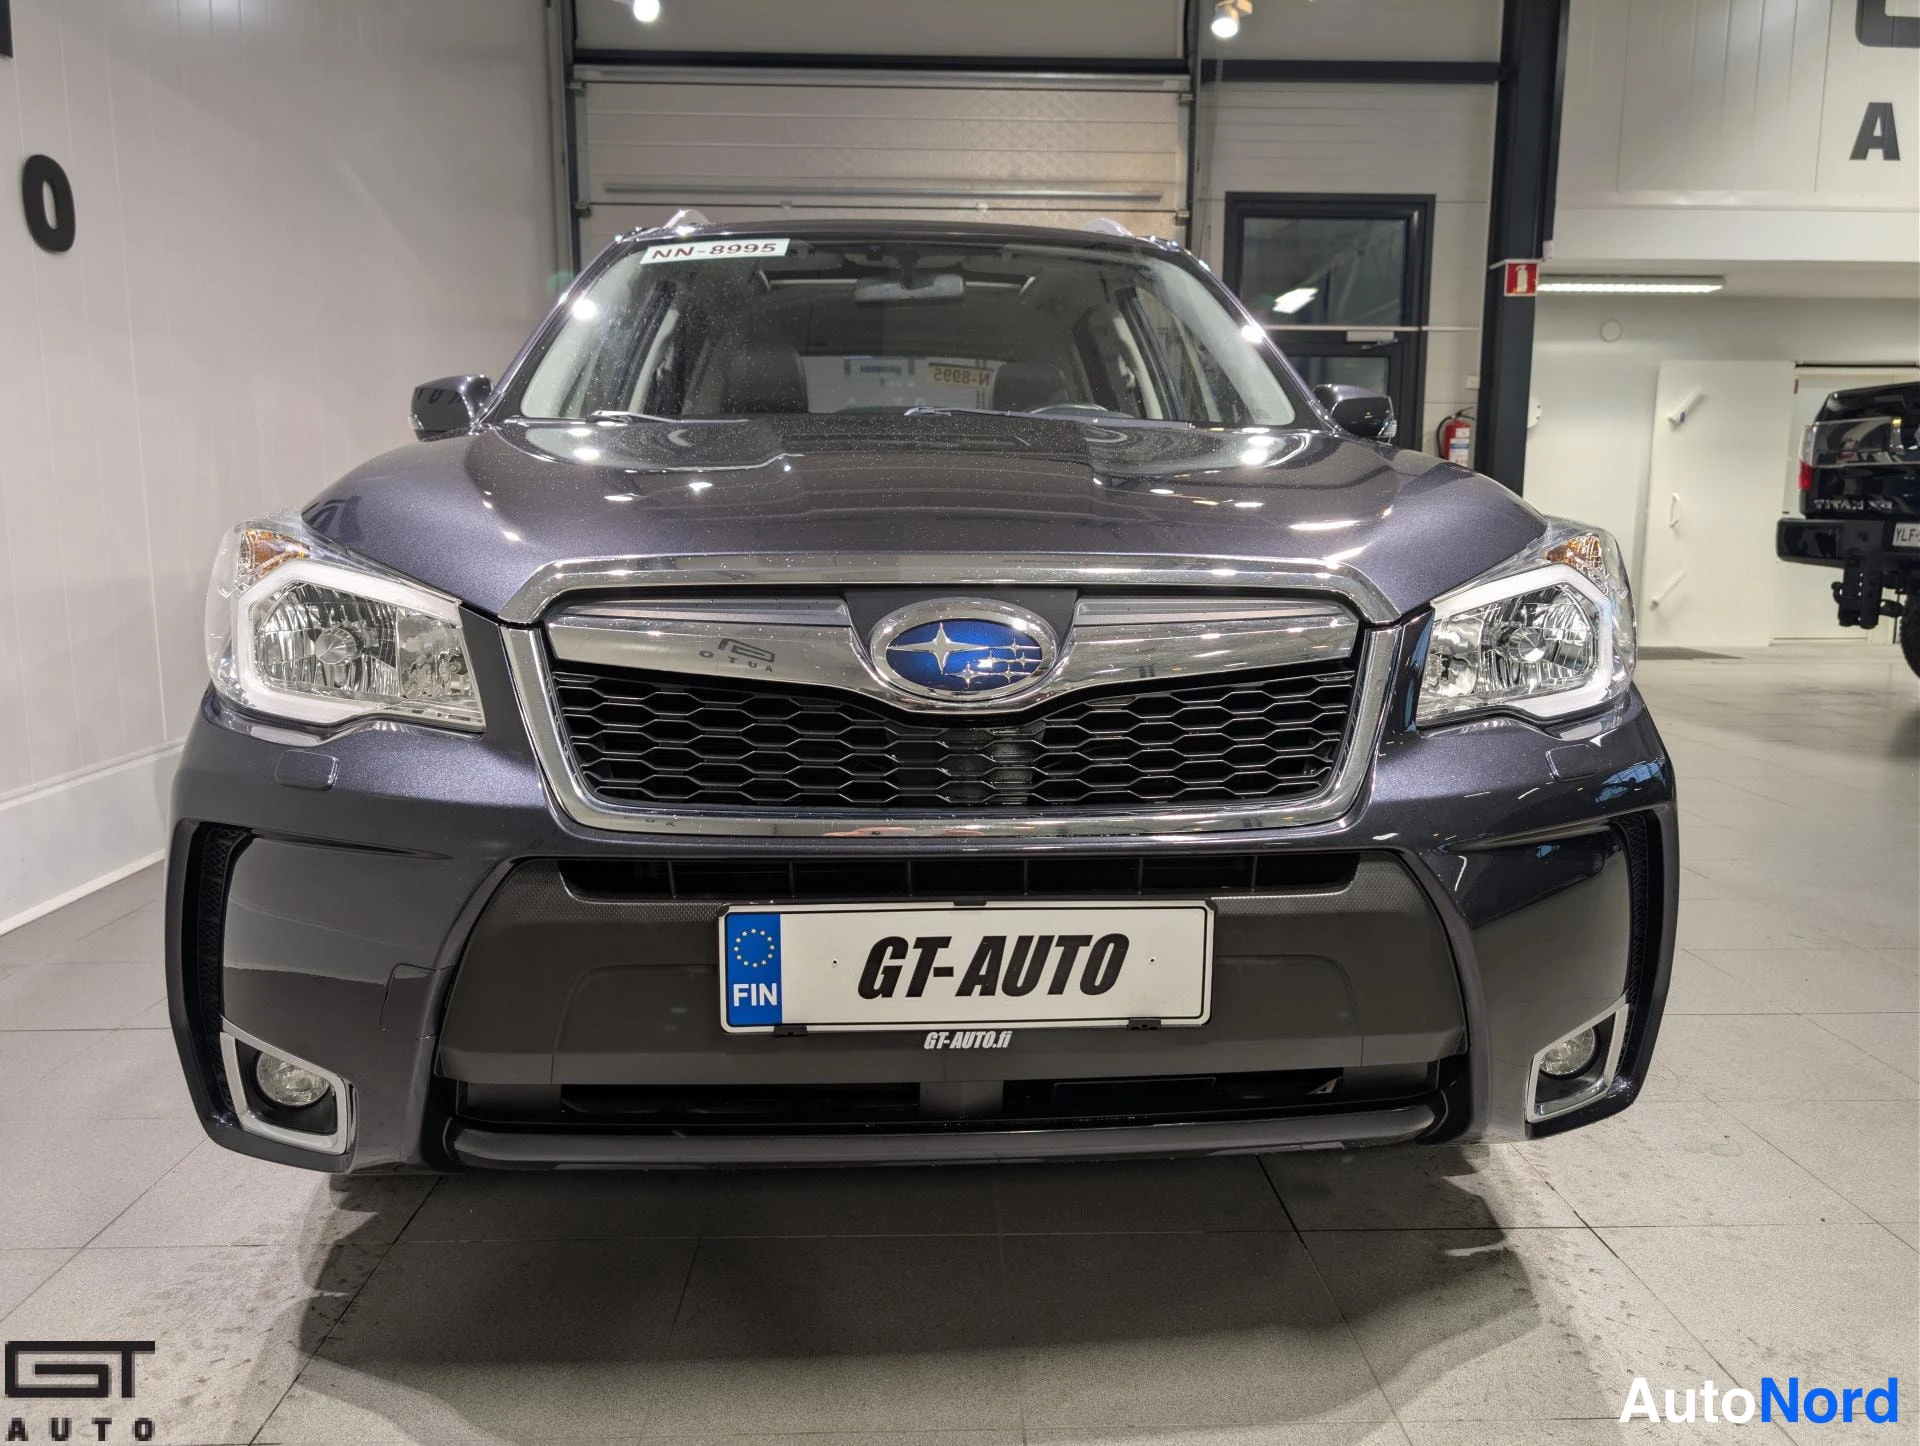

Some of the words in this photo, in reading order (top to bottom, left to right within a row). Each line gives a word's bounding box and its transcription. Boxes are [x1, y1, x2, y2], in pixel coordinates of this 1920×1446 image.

[652, 243, 777, 259] NN-8995
[1814, 499, 1864, 510] TITAN
[1895, 527, 1920, 542] YLF-
[858, 933, 1130, 999] GT-AUTO
[733, 983, 778, 1007] FIN
[923, 1030, 1013, 1049] GT-AUTO.fi
